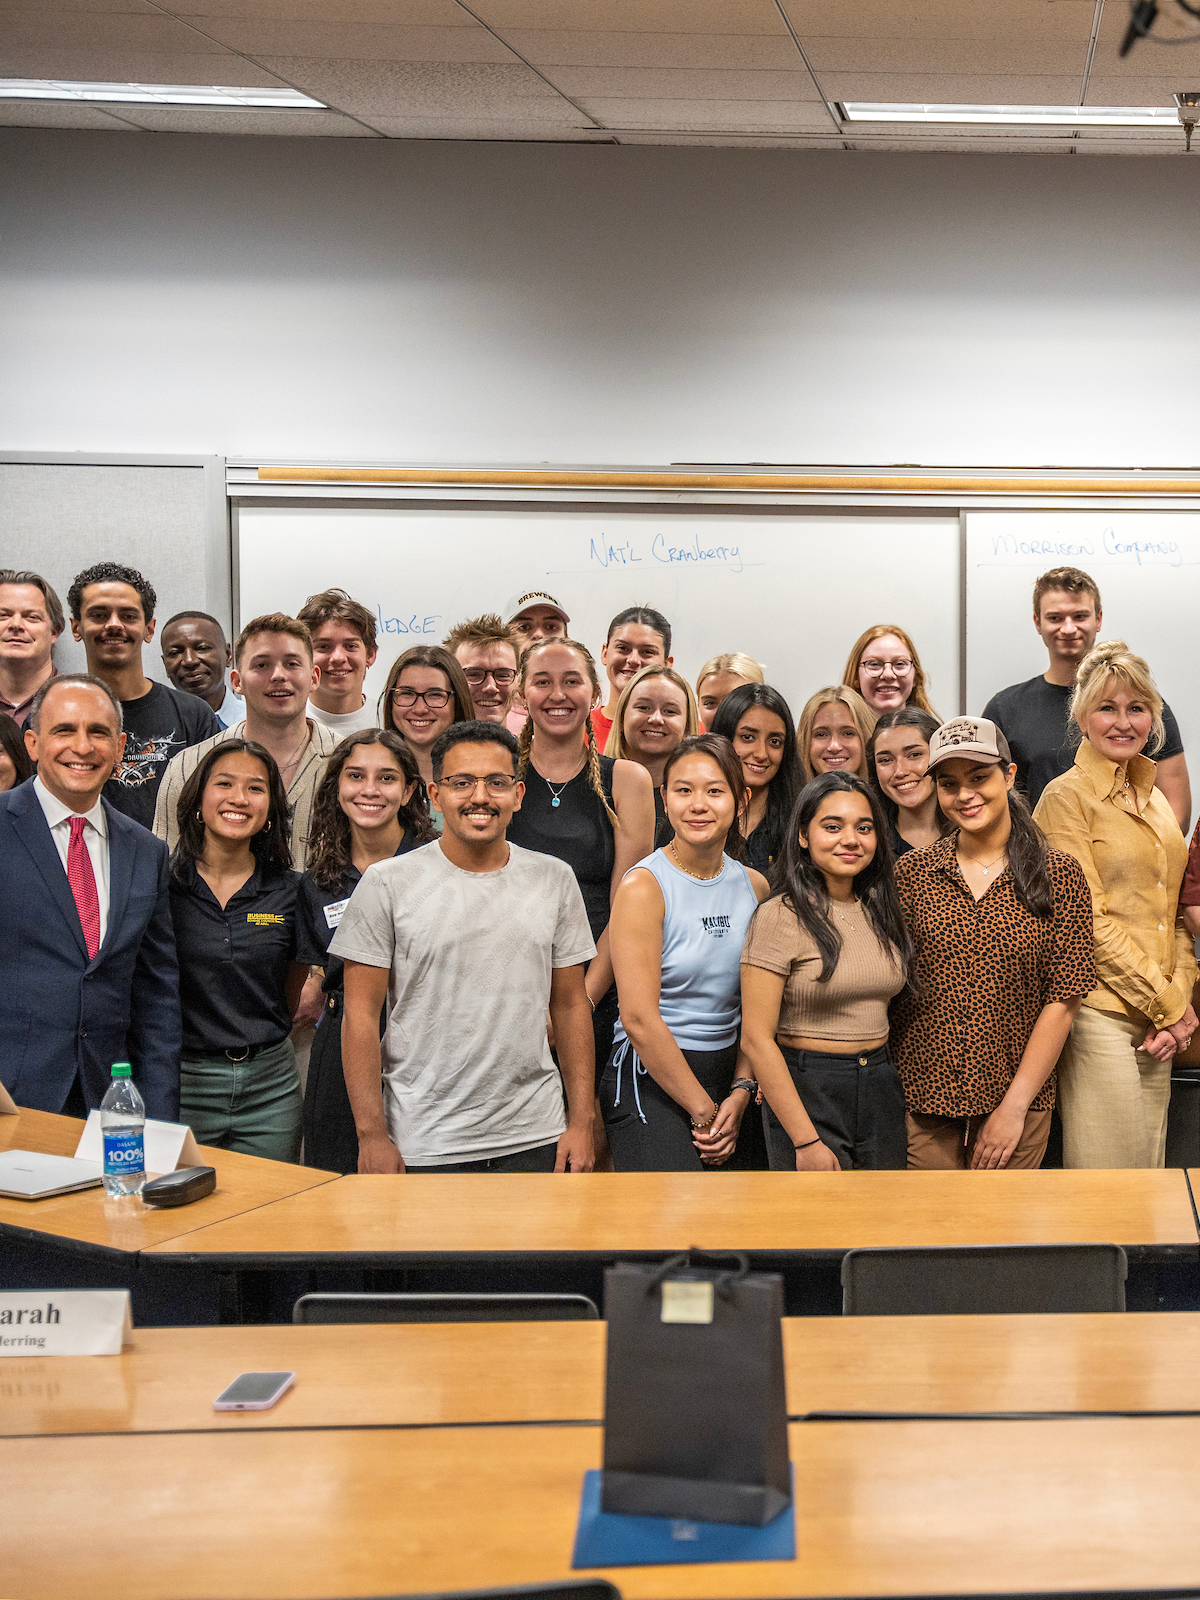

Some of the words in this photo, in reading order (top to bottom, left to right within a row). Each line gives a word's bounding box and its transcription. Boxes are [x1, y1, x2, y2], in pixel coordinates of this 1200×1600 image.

[702, 915, 730, 930] MALIBU
[108, 1148, 144, 1161] 100%
[0, 1303, 61, 1325] arah
